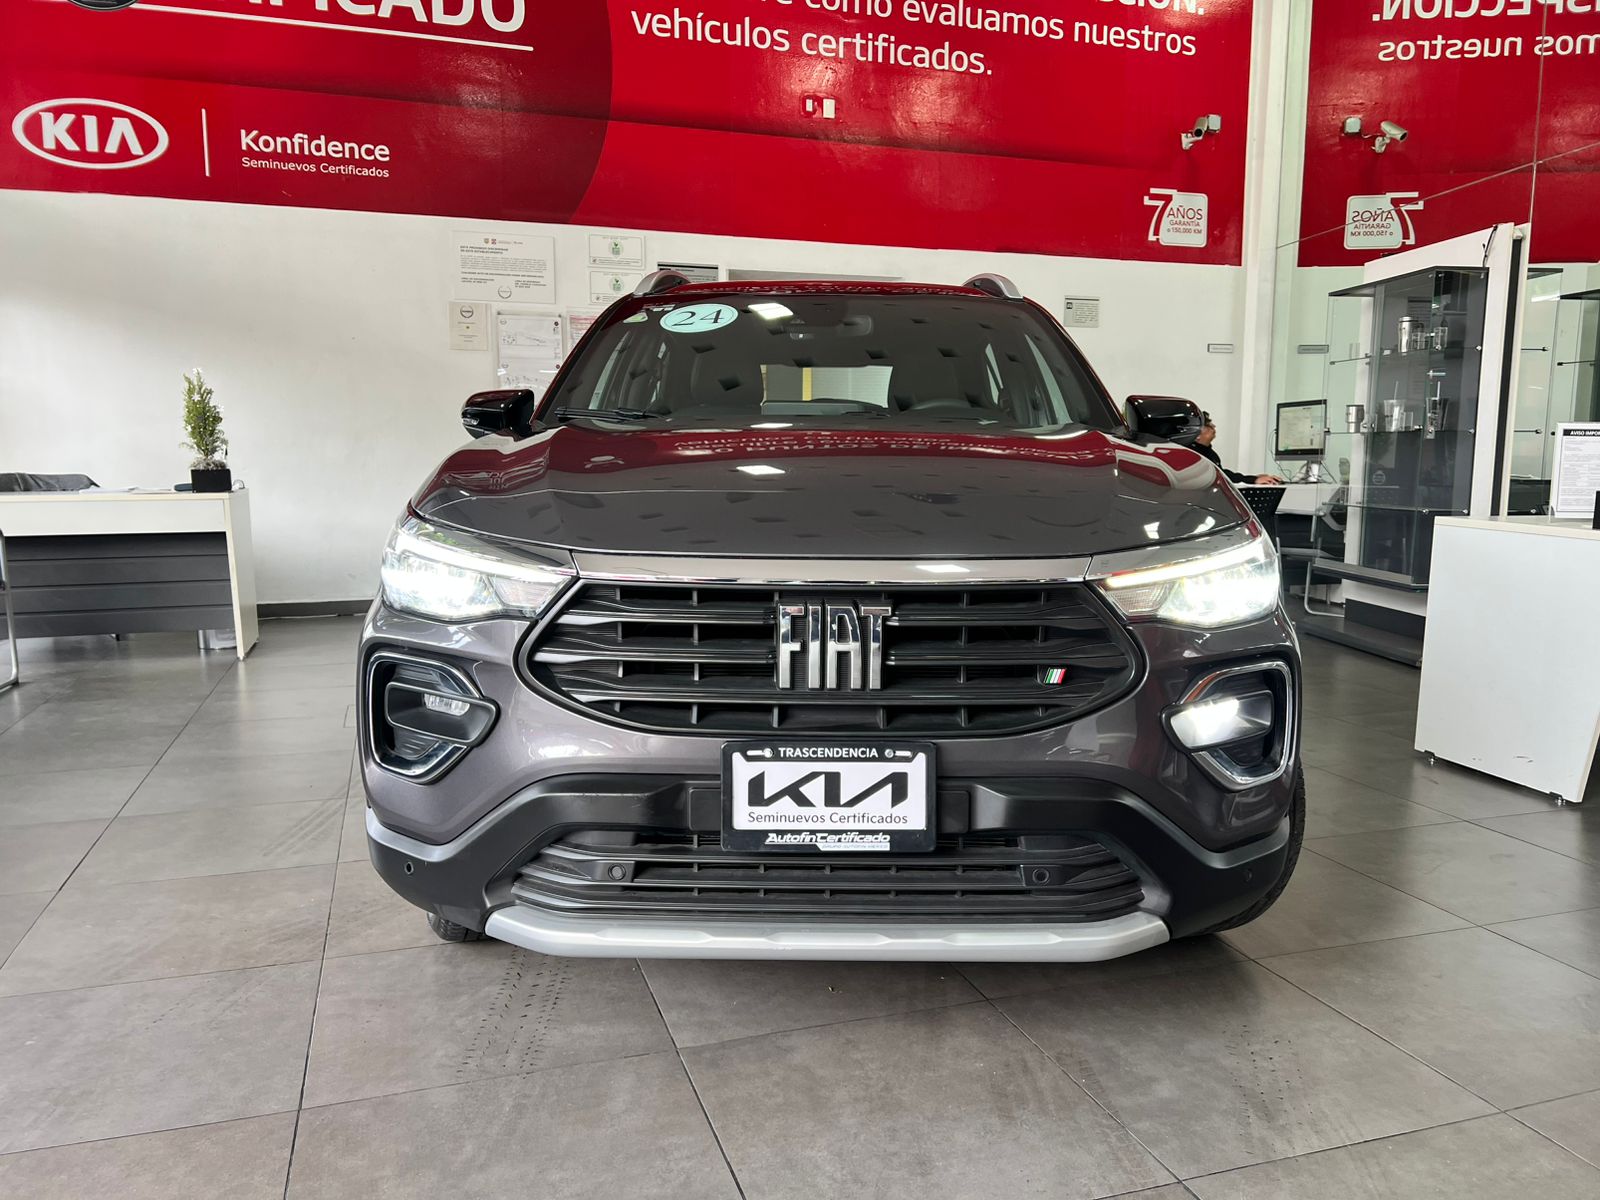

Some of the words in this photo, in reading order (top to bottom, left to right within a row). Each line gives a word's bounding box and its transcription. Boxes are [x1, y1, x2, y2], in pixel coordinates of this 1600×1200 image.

[631, 7, 790, 52] vehículos
[801, 31, 992, 75] certificados.
[903, 0, 1064, 40] evaluamos
[1074, 20, 1196, 56] nuestros
[39, 111, 145, 157] KIA
[240, 129, 390, 162] Konfidence
[241, 157, 316, 172] Seminuevos
[320, 163, 390, 178] Certificados
[1144, 187, 1178, 242] 7
[1167, 205, 1203, 220] AÑOS
[671, 309, 724, 327] 24
[778, 604, 893, 690] FIAT
[778, 747, 879, 758] TRASCENDENCIA
[747, 770, 909, 809] KIA
[748, 811, 826, 823] Seminuevos
[829, 812, 909, 825] Certificados
